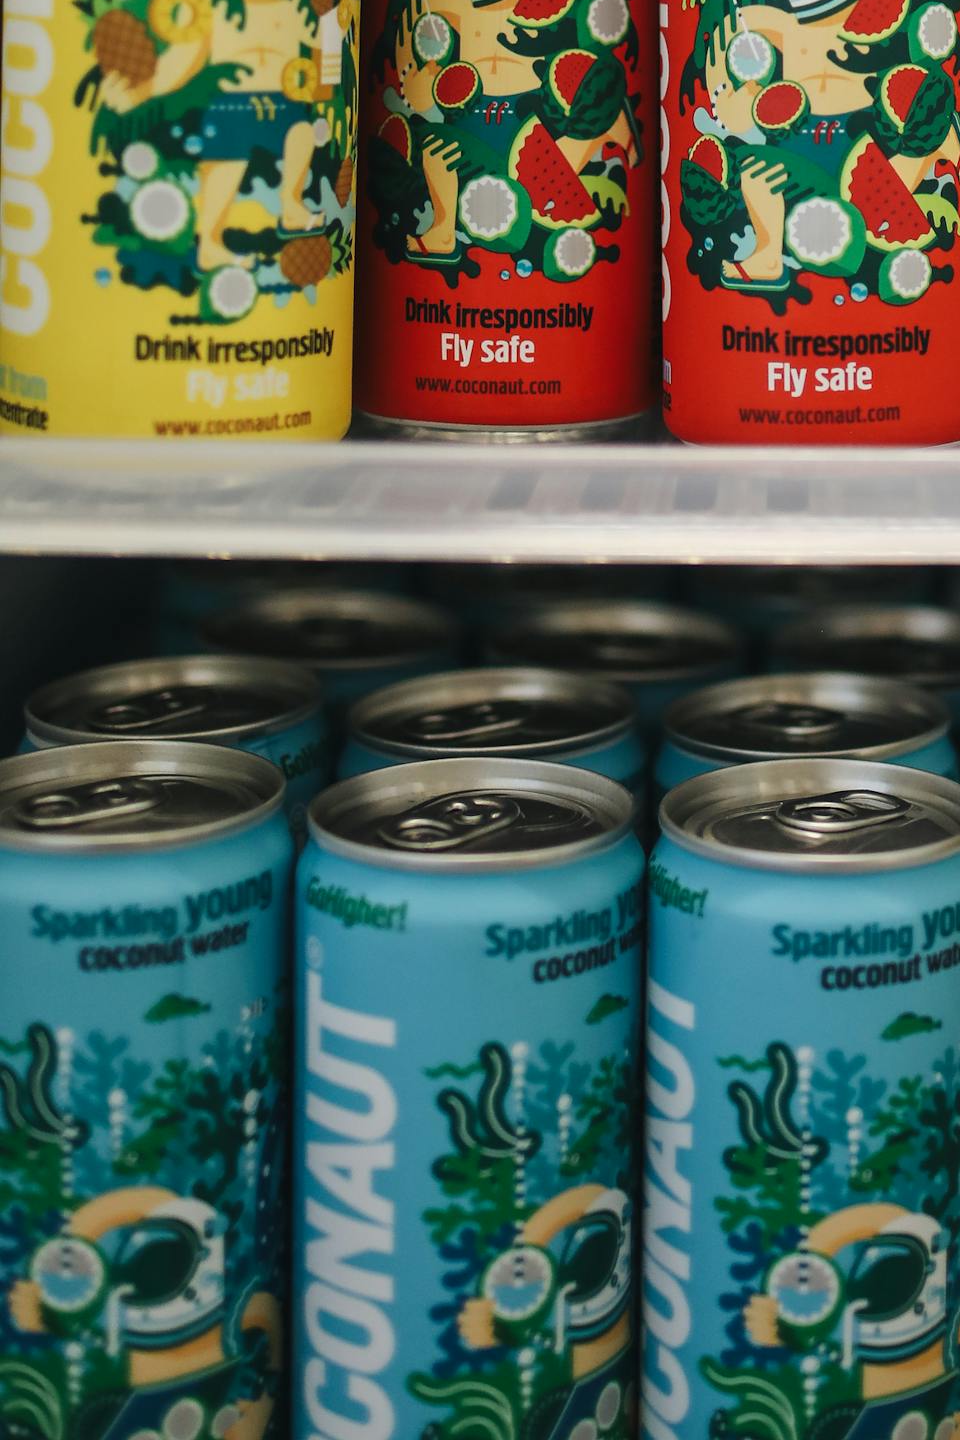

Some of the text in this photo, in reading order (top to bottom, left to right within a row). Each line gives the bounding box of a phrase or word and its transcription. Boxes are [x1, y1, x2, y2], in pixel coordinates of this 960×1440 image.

[405, 297, 593, 333] Drink irresponsibly
[135, 327, 335, 365] Drink irresponsibly
[441, 333, 535, 367] Fly safe
[722, 325, 931, 360] Drink irresponsibly
[186, 367, 289, 408] Fly safe
[415, 377, 561, 395] www.coconaut.com
[768, 362, 873, 398] Fly safe
[155, 410, 312, 436] www.coconaut.com
[740, 405, 900, 425] www.coconaut.com
[31, 869, 272, 943] Sparkling young
[79, 920, 250, 972] coconut water
[484, 907, 612, 959] Sparkling
[772, 923, 913, 960] Sparkling
[532, 937, 615, 983] coconut
[821, 955, 921, 990] coconut
